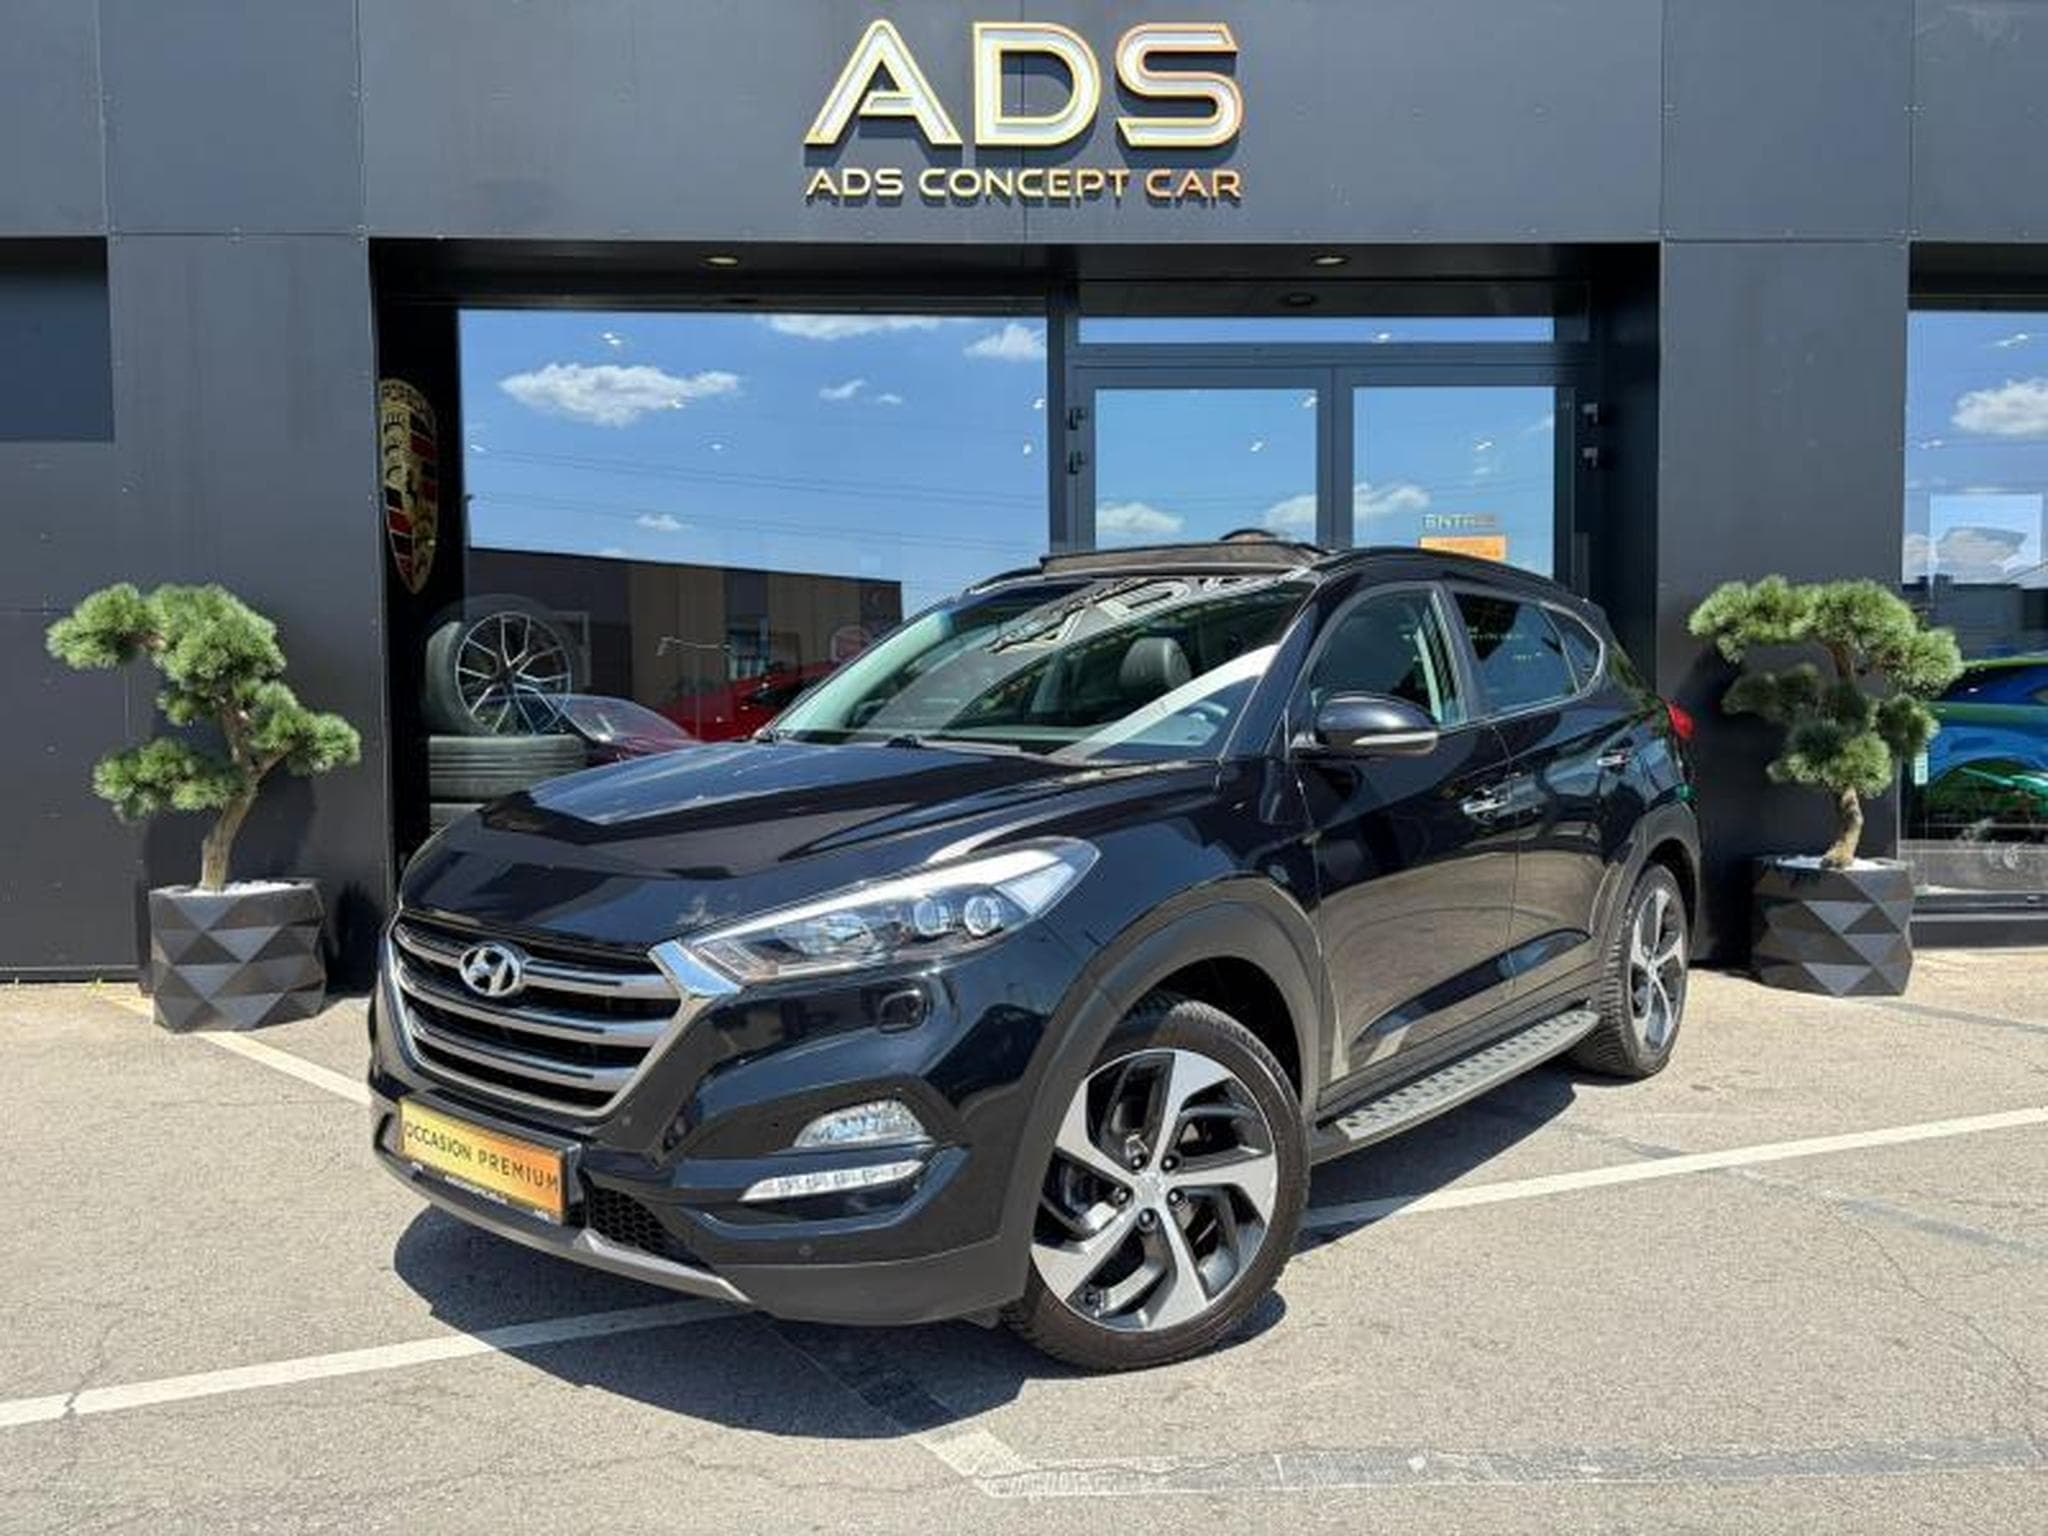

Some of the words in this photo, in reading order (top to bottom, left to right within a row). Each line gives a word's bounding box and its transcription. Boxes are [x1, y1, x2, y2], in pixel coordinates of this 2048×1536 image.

[804, 19, 1244, 147] ADS
[806, 168, 903, 198] ADS
[919, 168, 1130, 198] CONCEPT
[1145, 168, 1241, 197] CAR
[404, 1121, 472, 1162] OCCASION
[478, 1150, 560, 1192] PREMIUM
